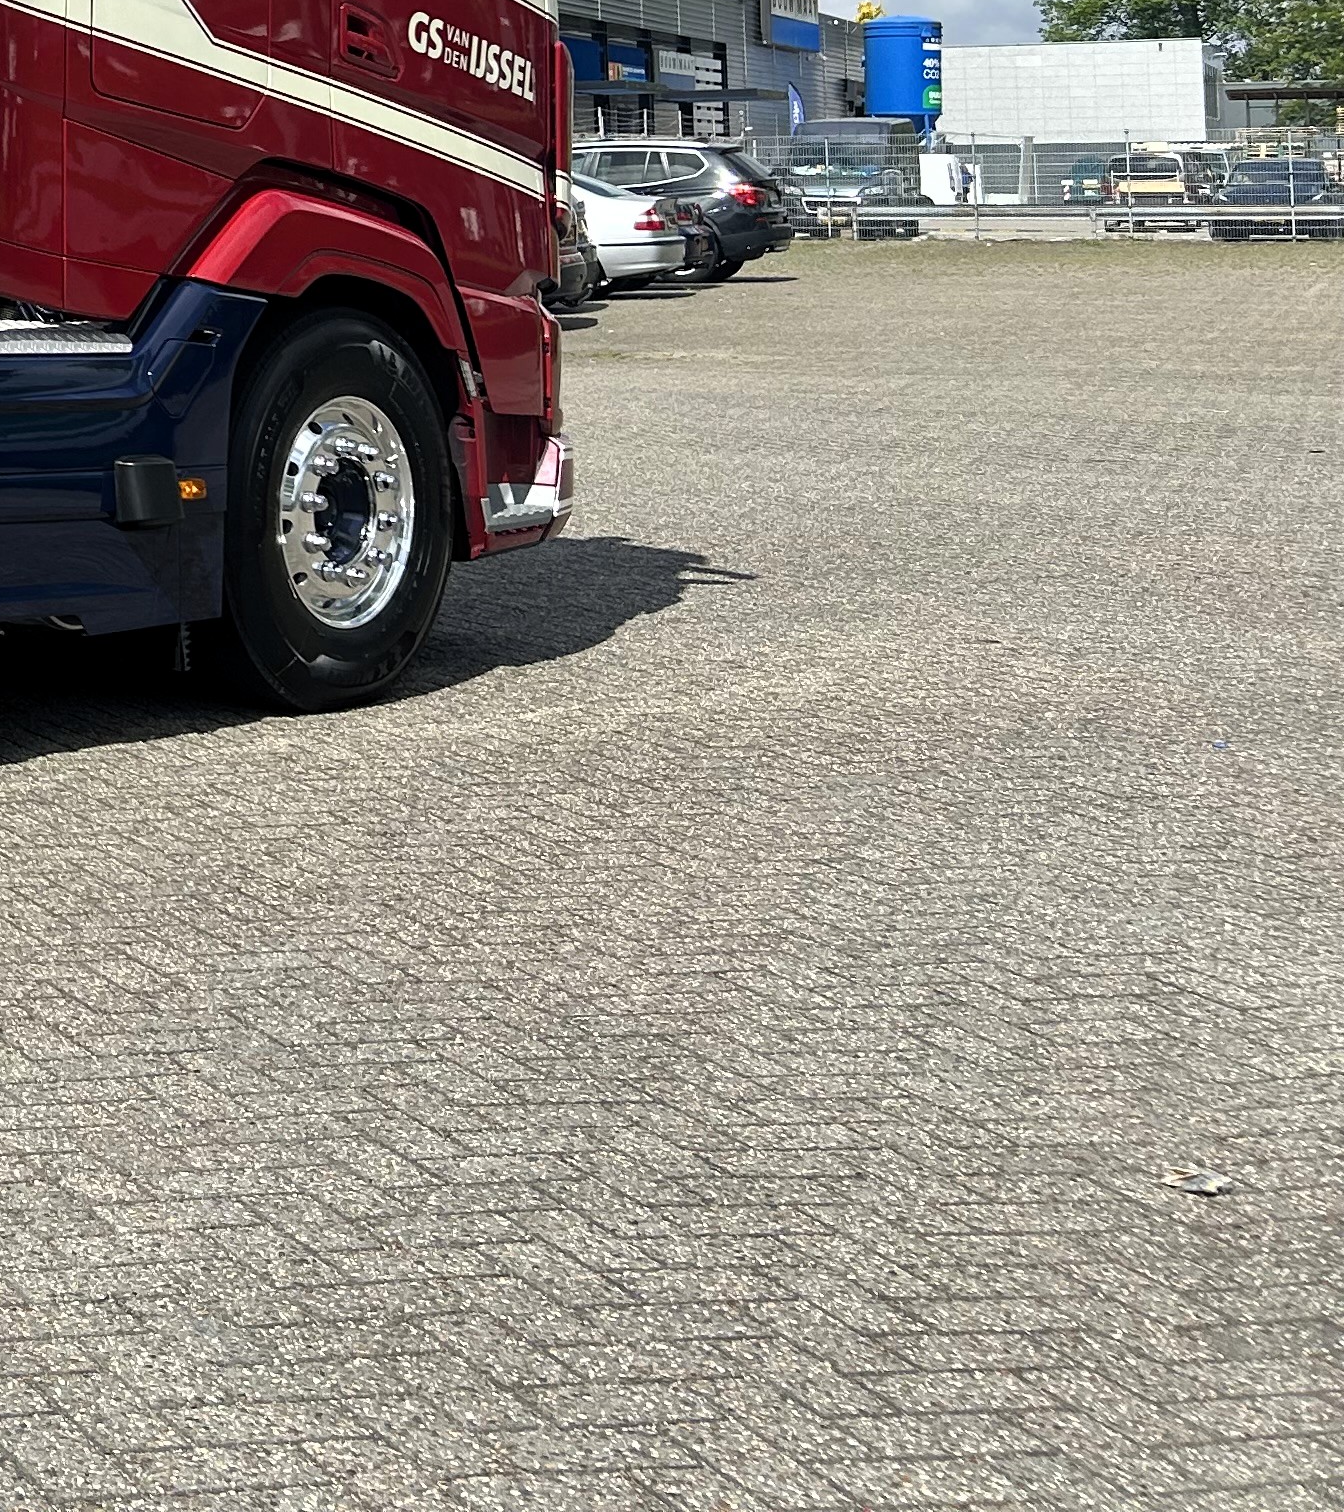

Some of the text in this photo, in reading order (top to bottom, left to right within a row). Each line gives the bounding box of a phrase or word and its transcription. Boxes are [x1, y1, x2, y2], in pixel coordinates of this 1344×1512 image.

[408, 11, 534, 103] GS VAN DEN IJSSEL
